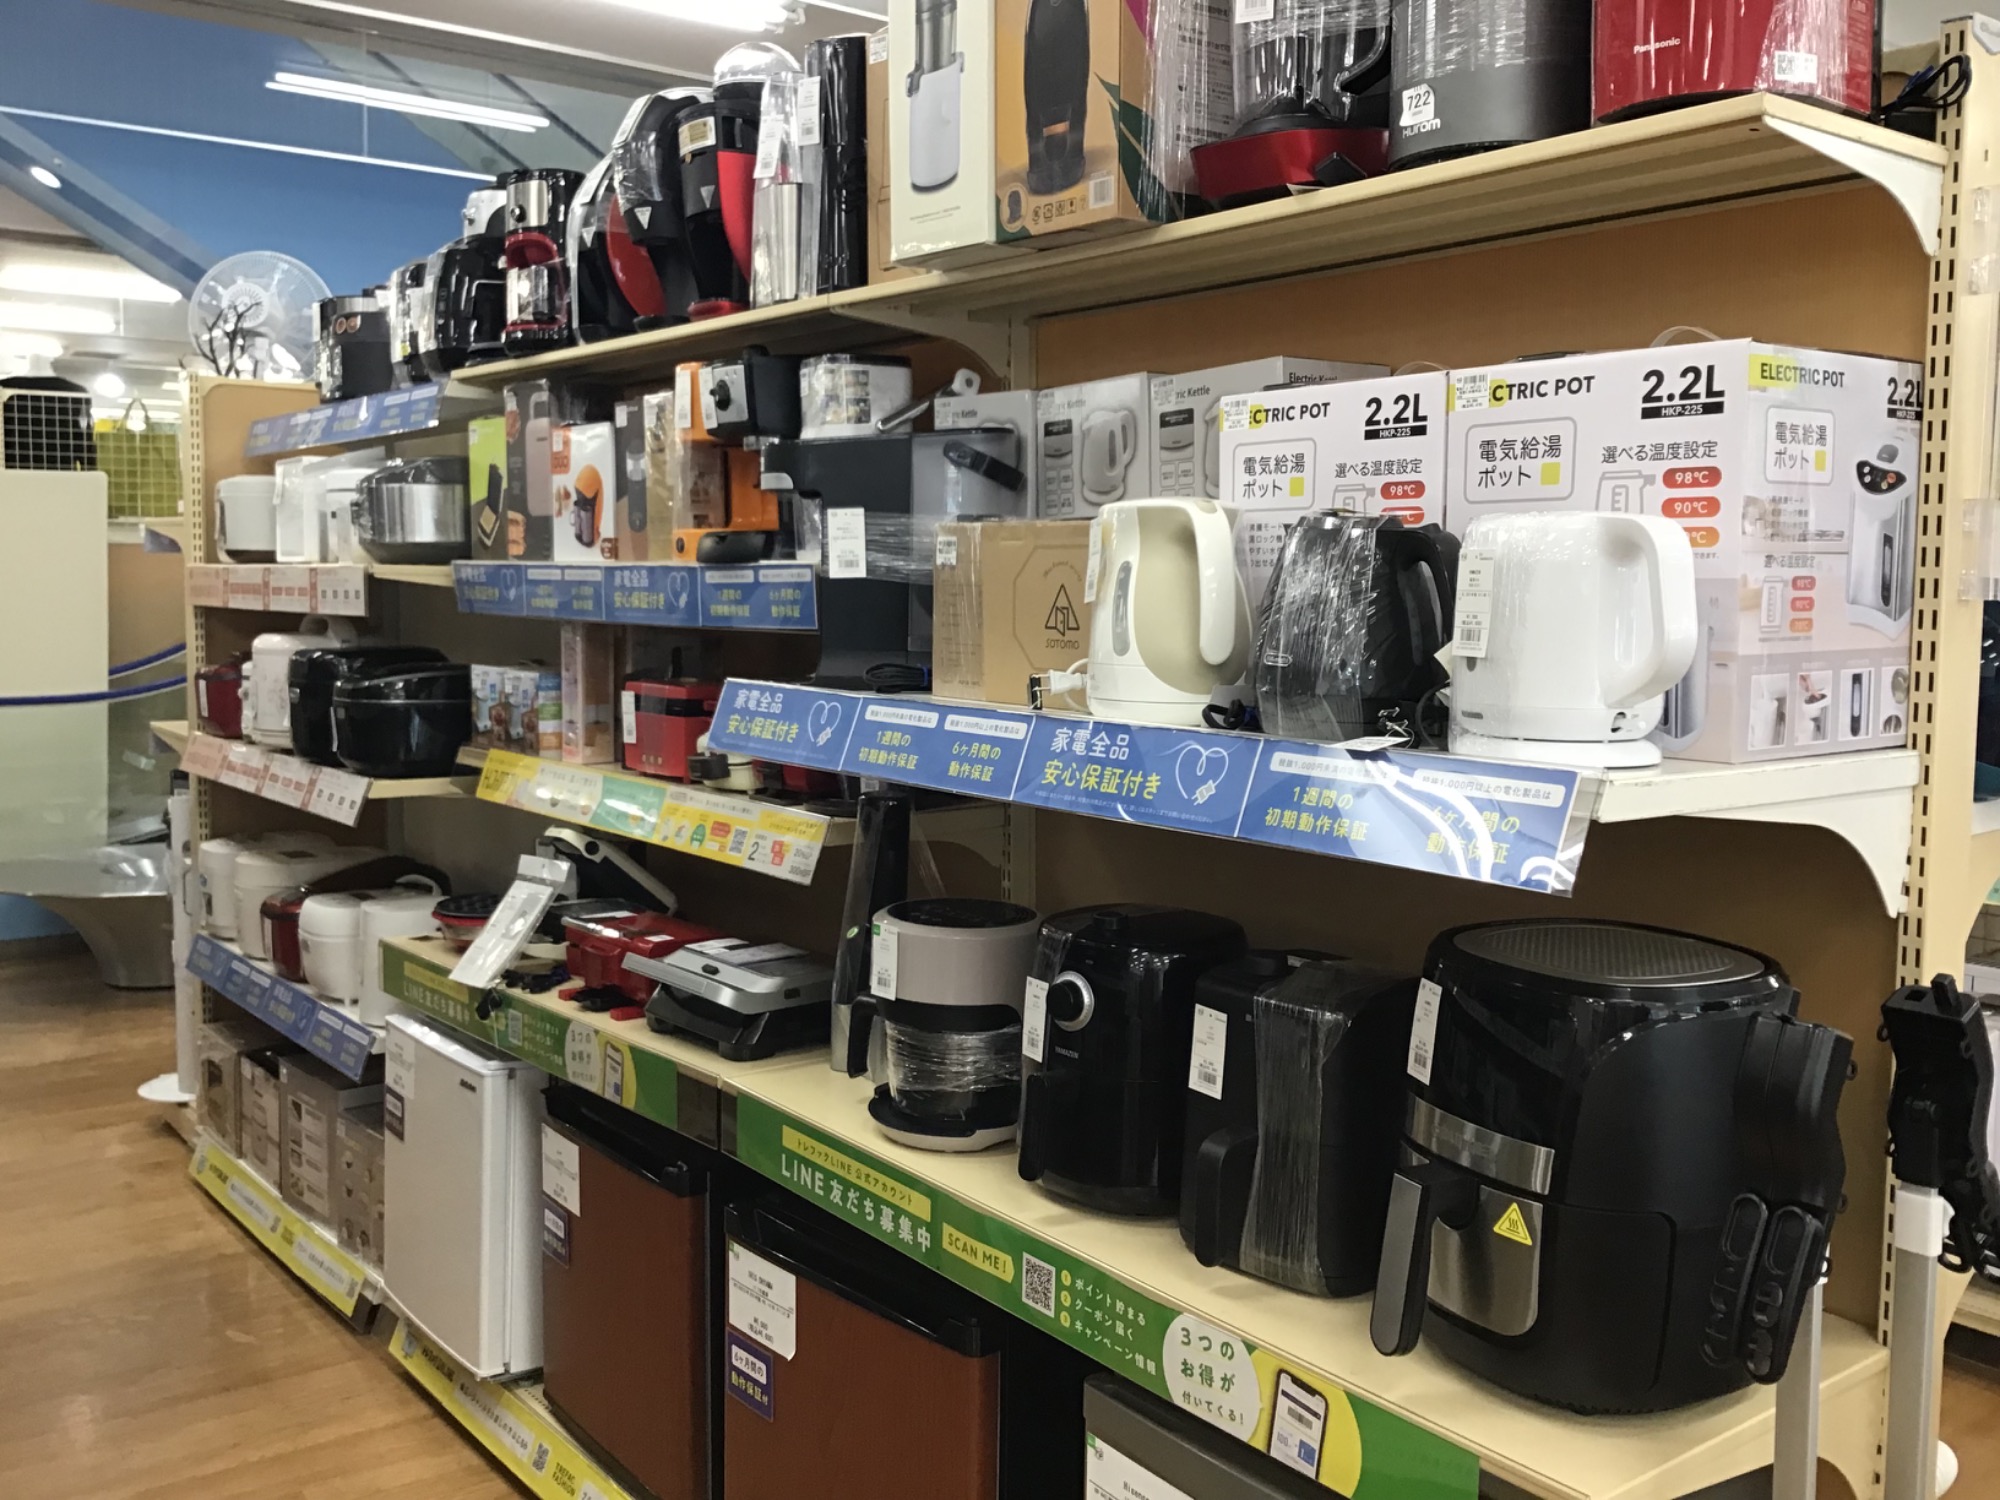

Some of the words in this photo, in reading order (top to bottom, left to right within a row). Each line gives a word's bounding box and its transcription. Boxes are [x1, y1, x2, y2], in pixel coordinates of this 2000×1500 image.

[1633, 36, 1681, 54] Panasonic
[1407, 90, 1431, 111] 722
[1641, 364, 1726, 404] 2.2L
[1760, 362, 1821, 385] ELECTRIC
[1823, 369, 1845, 388] POT
[1187, 384, 1212, 399] Kettle
[1492, 380, 1549, 403] CTRIC
[1554, 376, 1596, 397] POT
[1248, 405, 1296, 426] CTRIC
[1299, 402, 1332, 421] POT
[1364, 393, 1429, 427] 2.2L
[1661, 404, 1704, 417] HKP-225
[1379, 426, 1412, 439] HKP-225
[1774, 421, 1828, 448] 電気給湯
[1478, 434, 1563, 463] 電気給湯
[1601, 440, 1719, 464] 選べる温度設定
[1773, 447, 1810, 471] ポット
[1242, 452, 1306, 477] 電気給湯
[1334, 458, 1423, 479] 選べる温度設定
[1477, 464, 1532, 489] ポット
[1242, 478, 1283, 499] ポット
[1674, 470, 1709, 485] 98°C
[1389, 484, 1417, 497] 98°C
[1673, 499, 1708, 515] 90°C
[1045, 638, 1080, 650] SOTOMO
[733, 688, 784, 714] 家電全品
[726, 713, 799, 744] 安心保証付き
[876, 730, 911, 748] 1週間の
[1050, 726, 1131, 761] 家電全品
[859, 746, 919, 770] 初期動作保証
[947, 760, 995, 783] 動作保証
[1041, 758, 1162, 800] 安心保証付き
[1293, 785, 1354, 811] 1週間の
[1264, 806, 1371, 842] 初期動作保証
[947, 1232, 978, 1261] SCAN
[1075, 1319, 1157, 1376] キャンペーン情報
[1180, 1326, 1235, 1361] 3つの
[1180, 1357, 1236, 1393] お得が
[552, 1471, 577, 1497] FASHION
[556, 1461, 576, 1485] TREFAC
